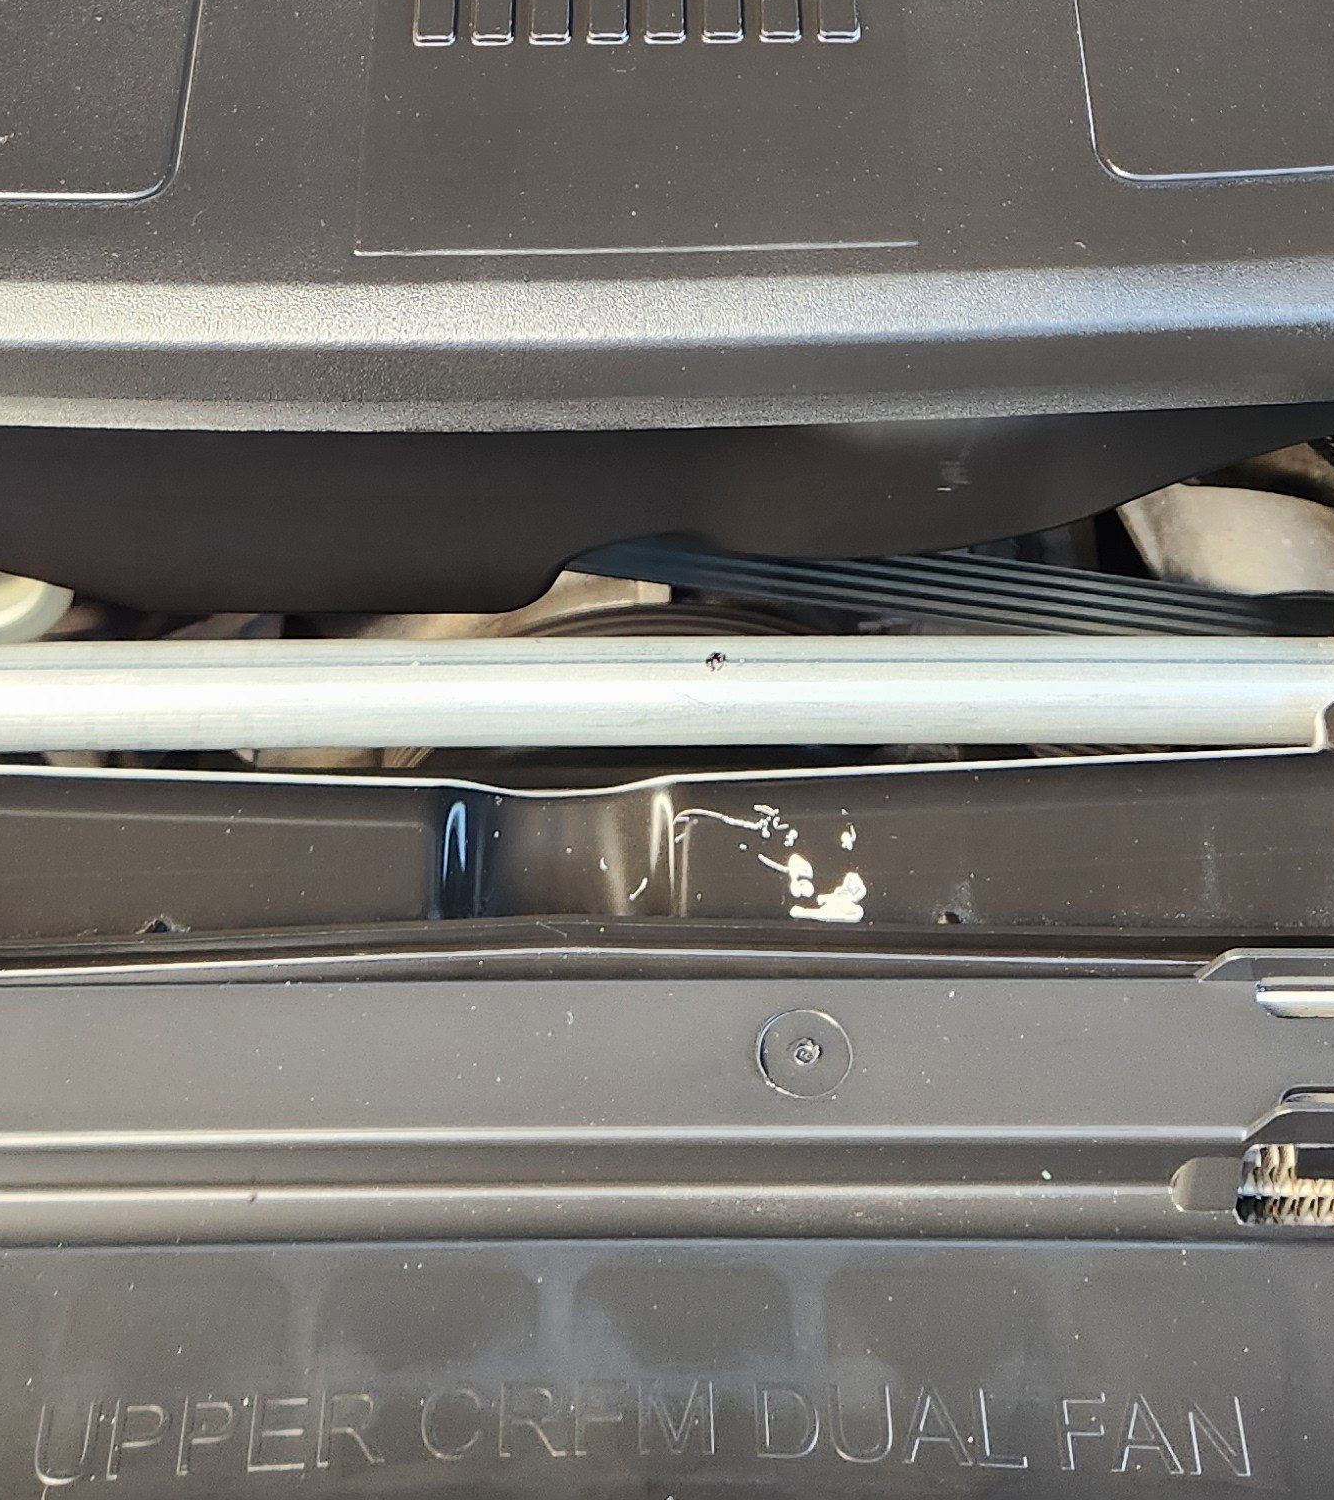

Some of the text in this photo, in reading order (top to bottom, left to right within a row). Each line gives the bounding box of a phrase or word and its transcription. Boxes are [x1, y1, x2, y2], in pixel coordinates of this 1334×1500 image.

[33, 1379, 1252, 1486] UPPER CRFM DUAL FAN
